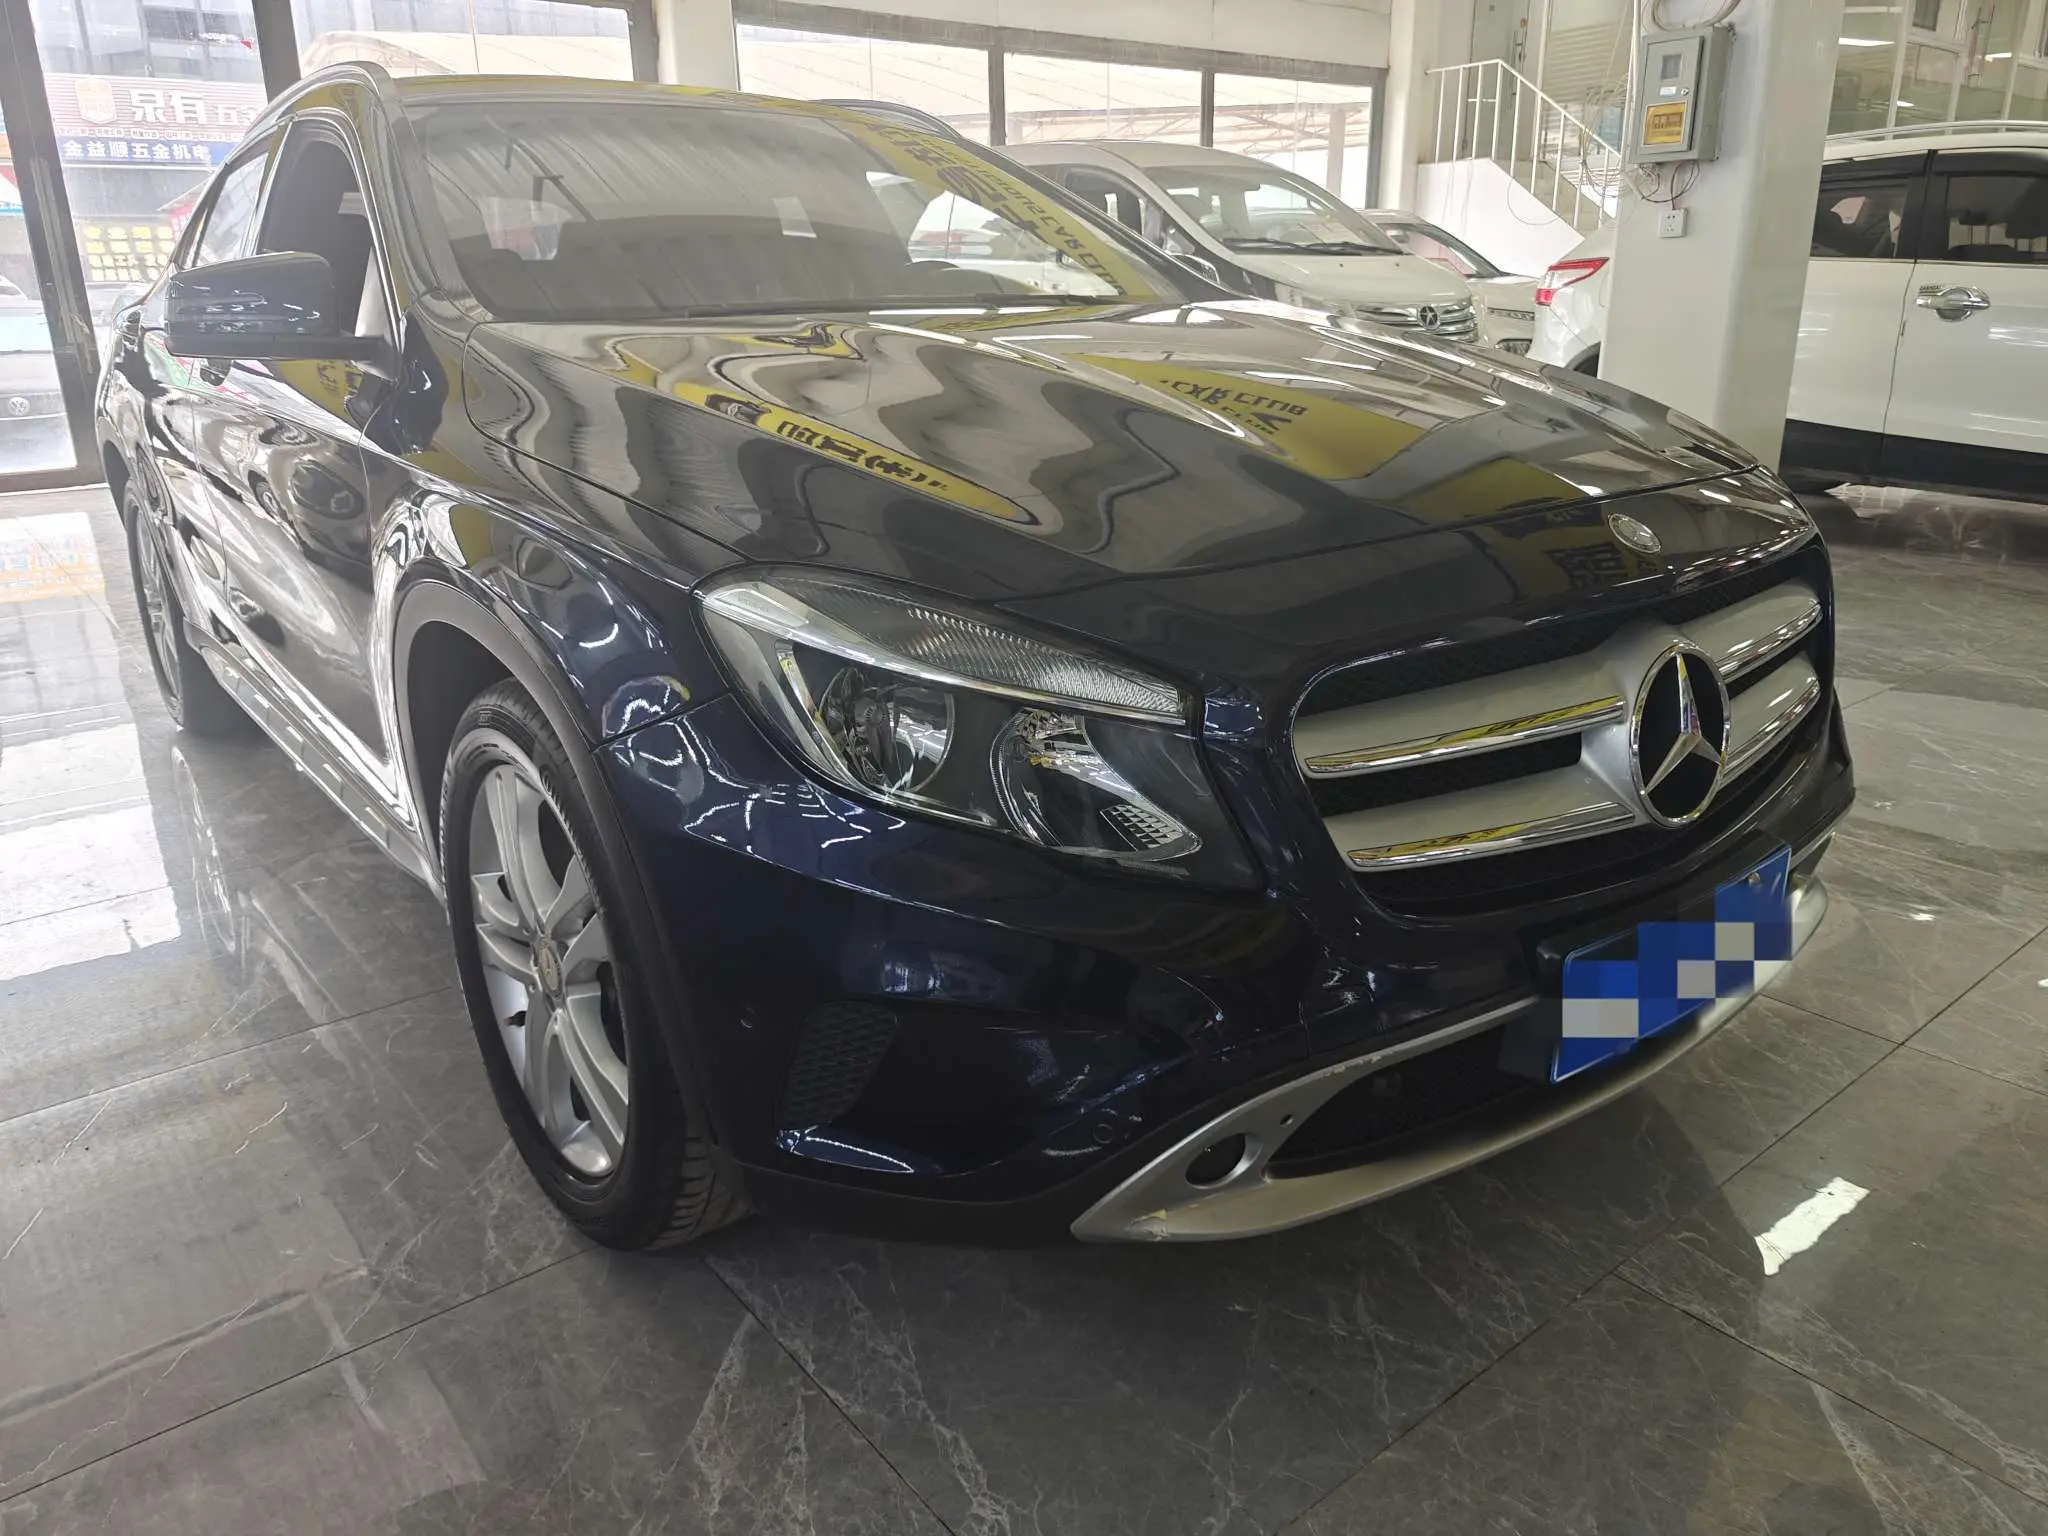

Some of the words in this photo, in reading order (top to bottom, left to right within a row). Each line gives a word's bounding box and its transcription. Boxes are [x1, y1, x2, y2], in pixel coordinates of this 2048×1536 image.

[62, 139, 212, 161] 金益顺五金机电
